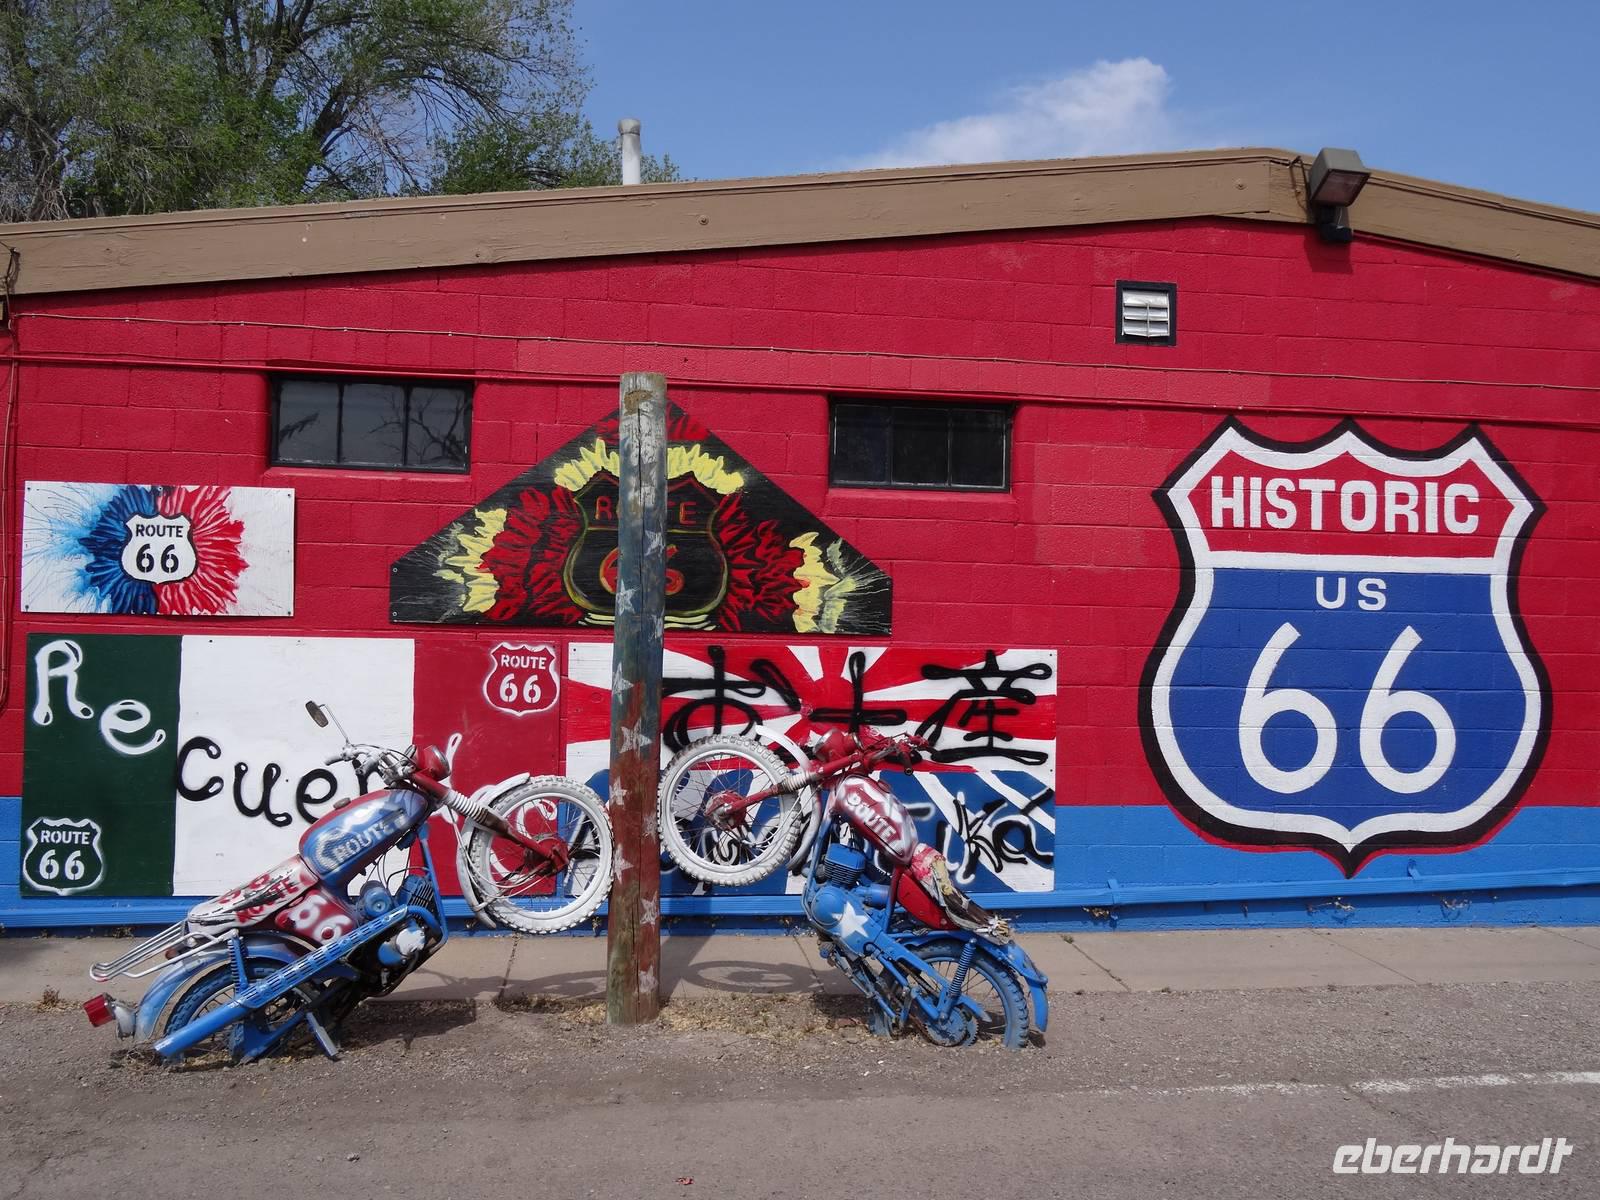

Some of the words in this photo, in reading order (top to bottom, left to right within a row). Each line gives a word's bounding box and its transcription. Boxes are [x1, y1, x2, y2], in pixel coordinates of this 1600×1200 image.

[1211, 476, 1479, 534] HISTORIC
[135, 524, 184, 538] ROUTE
[136, 543, 179, 574] 66
[1316, 577, 1386, 610] US
[501, 654, 547, 670] ROUTE
[500, 673, 541, 704] 66
[1238, 622, 1456, 794] 66
[40, 830, 90, 844] ROUTE
[332, 818, 396, 862] ROUTE
[40, 849, 85, 880] 66
[289, 893, 354, 946] 66
